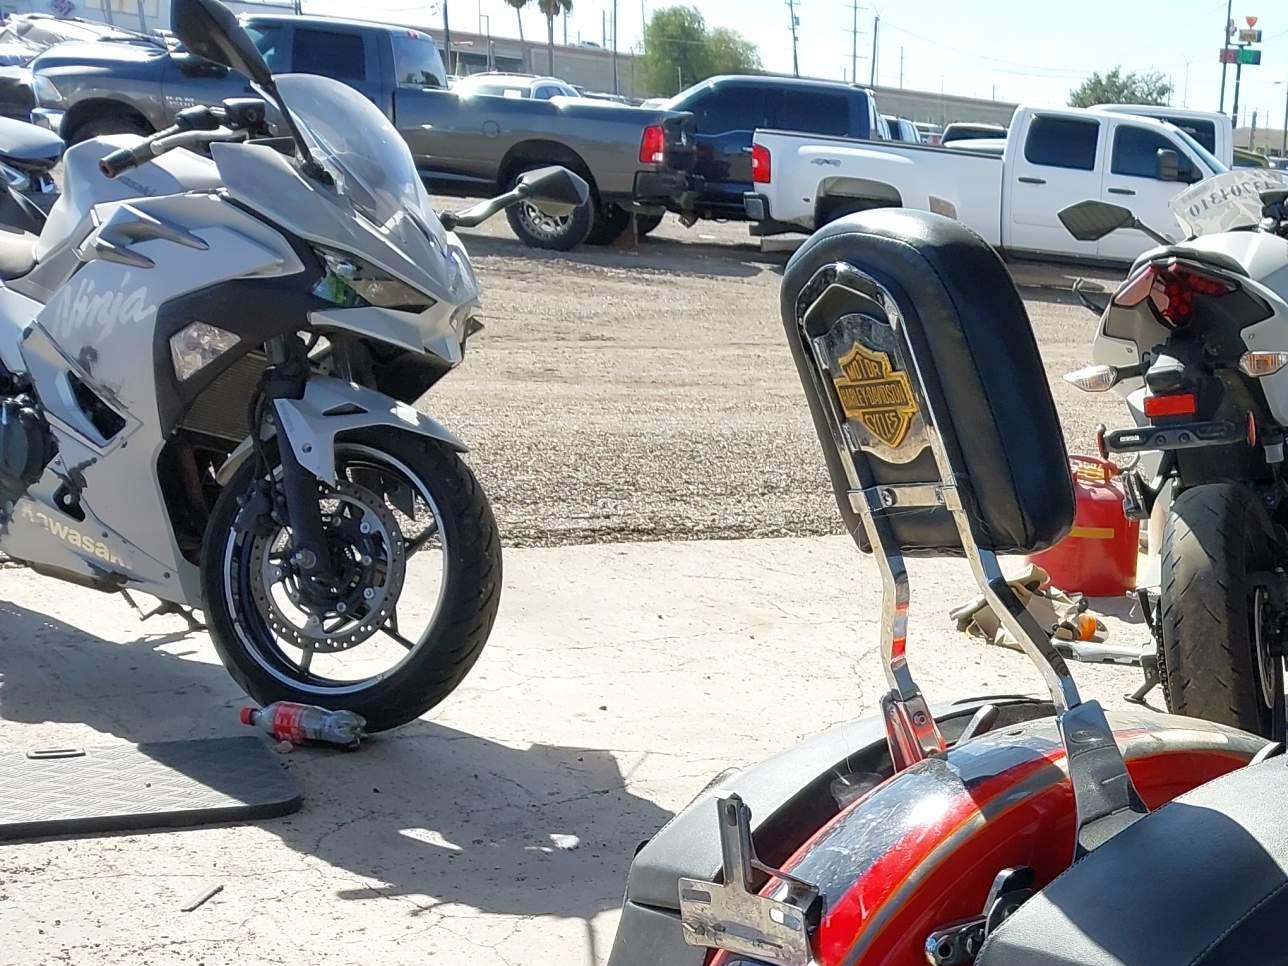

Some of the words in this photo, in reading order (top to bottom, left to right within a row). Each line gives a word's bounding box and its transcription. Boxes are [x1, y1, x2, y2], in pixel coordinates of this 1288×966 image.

[53, 271, 157, 341] Ninja
[846, 356, 880, 380] MOTOR
[863, 412, 896, 438] CYCLES
